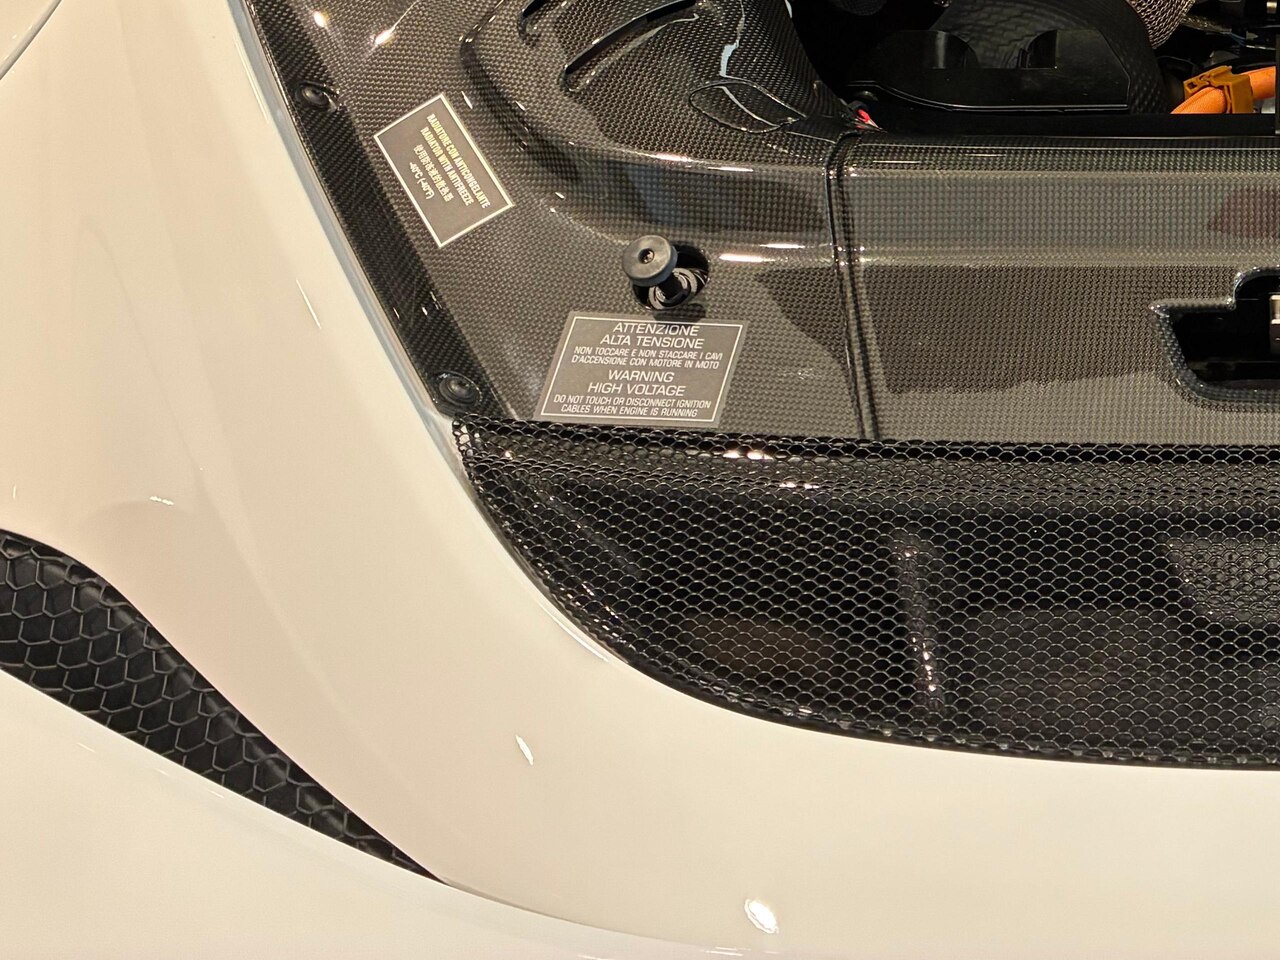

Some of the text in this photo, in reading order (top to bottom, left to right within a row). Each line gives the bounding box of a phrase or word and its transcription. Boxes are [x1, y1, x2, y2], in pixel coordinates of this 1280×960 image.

[420, 126, 474, 206] RADIATOR WITH ANTIFREEZE
[427, 113, 491, 209] RADIATORE CON ANTICONGELANTE
[613, 322, 700, 336] ATTENZIONE
[600, 334, 704, 349] ALTA TENSIONE
[574, 346, 592, 355] NON
[595, 347, 630, 356] TOCCARE
[631, 348, 638, 357] E
[638, 349, 657, 358] NON
[659, 350, 698, 360] STACCARE
[705, 352, 723, 360] CAVI
[572, 354, 720, 370] D'ACCENSIONE CON MOTORE IN MOTO
[608, 369, 675, 383] WARNING
[588, 382, 686, 396] HIGH VOLTAGE
[554, 394, 712, 408] DO NOT TOUCH OR DISCONNECT IGNITION
[561, 404, 698, 418] CABLES WHEN ENGINE IS RUNNING
